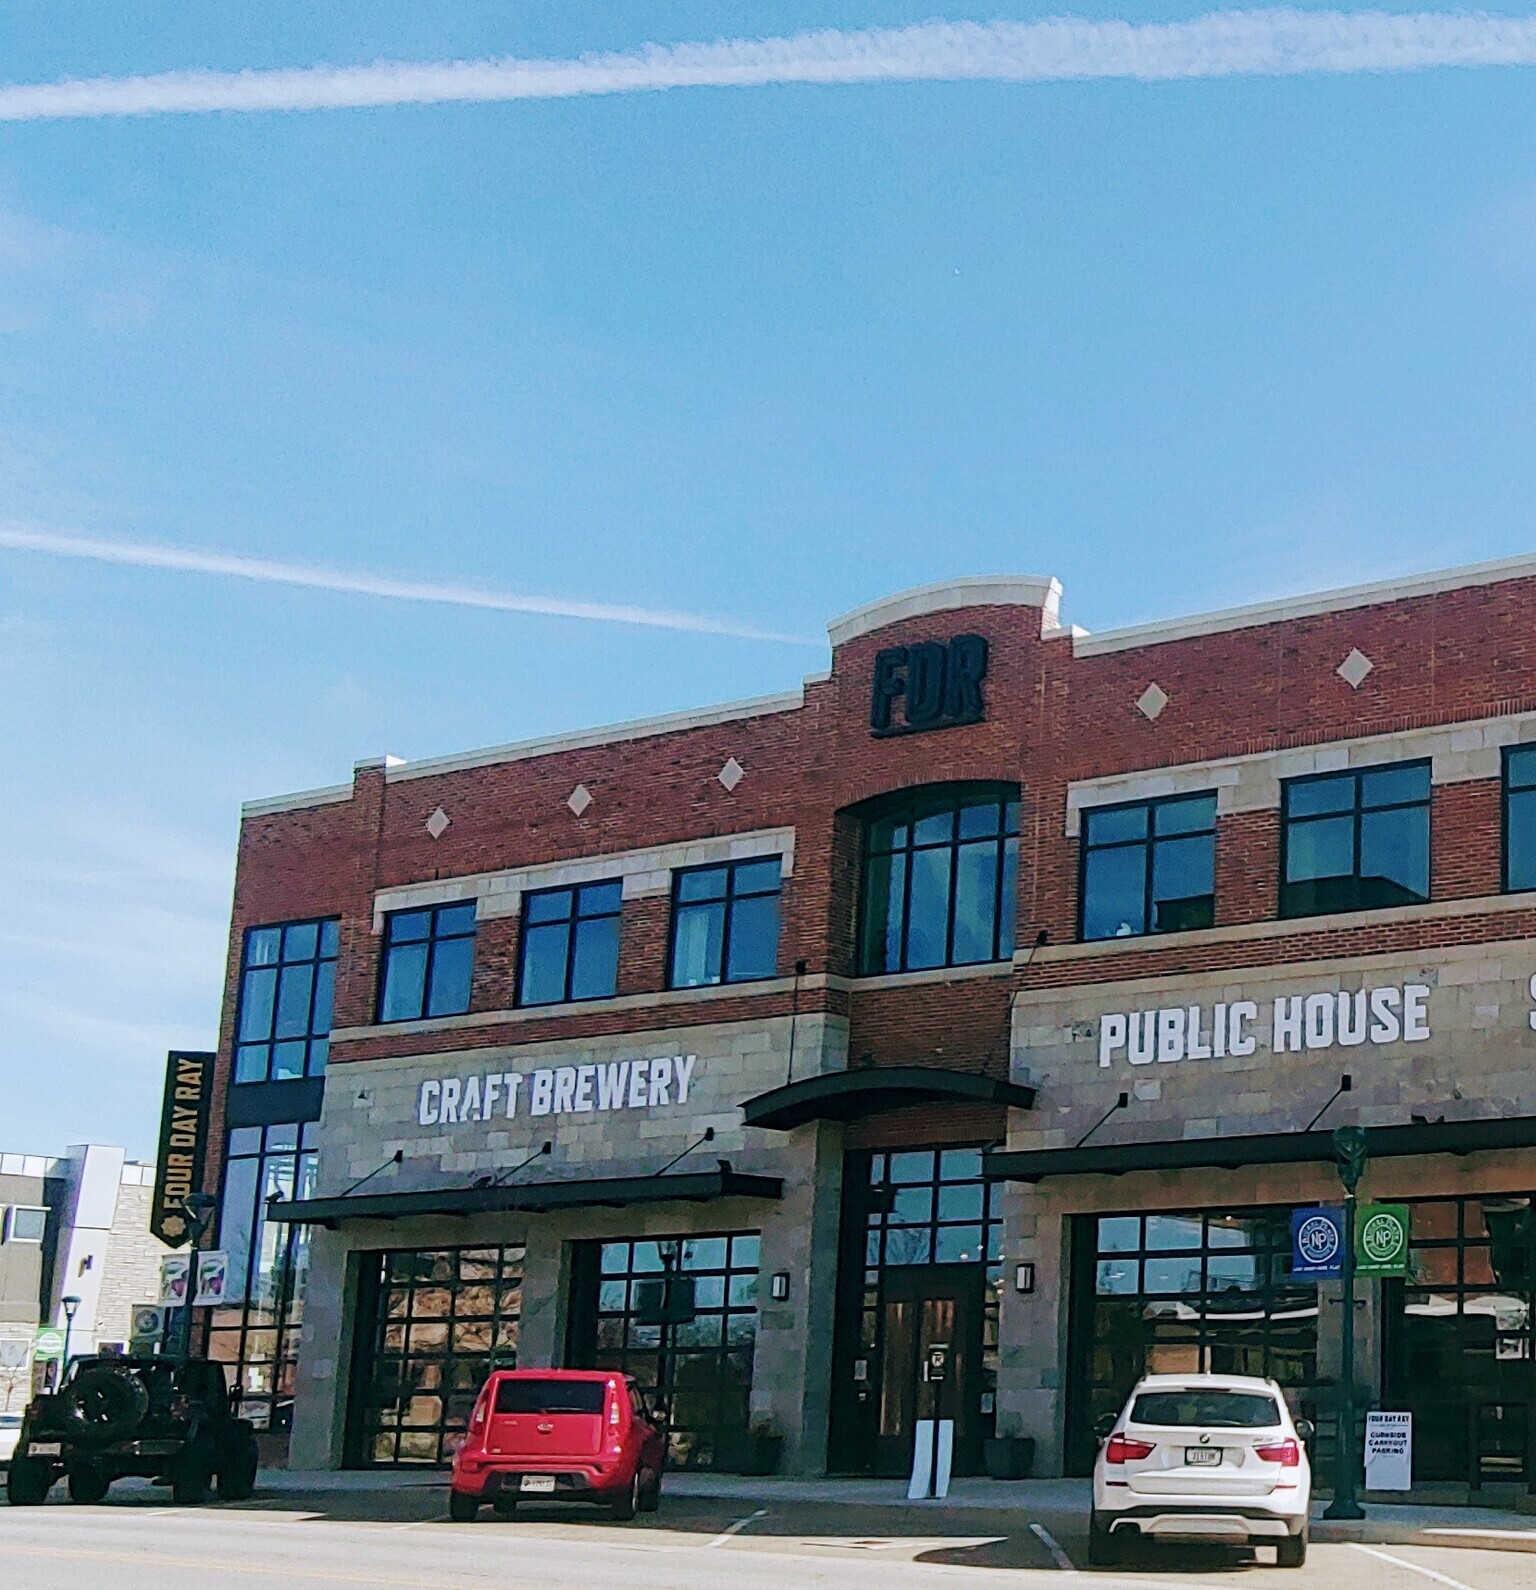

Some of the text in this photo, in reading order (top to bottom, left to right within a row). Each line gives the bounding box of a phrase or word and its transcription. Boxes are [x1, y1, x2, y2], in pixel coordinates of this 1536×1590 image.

[870, 633, 990, 730] FDR
[1099, 984, 1431, 1068] PUBLIC HOUSE
[419, 1055, 697, 1125] CRAFT BREWERY
[163, 1058, 203, 1209] FOUR DAY RAY
[1311, 1231, 1327, 1249] NP
[1376, 1229, 1391, 1247] NP
